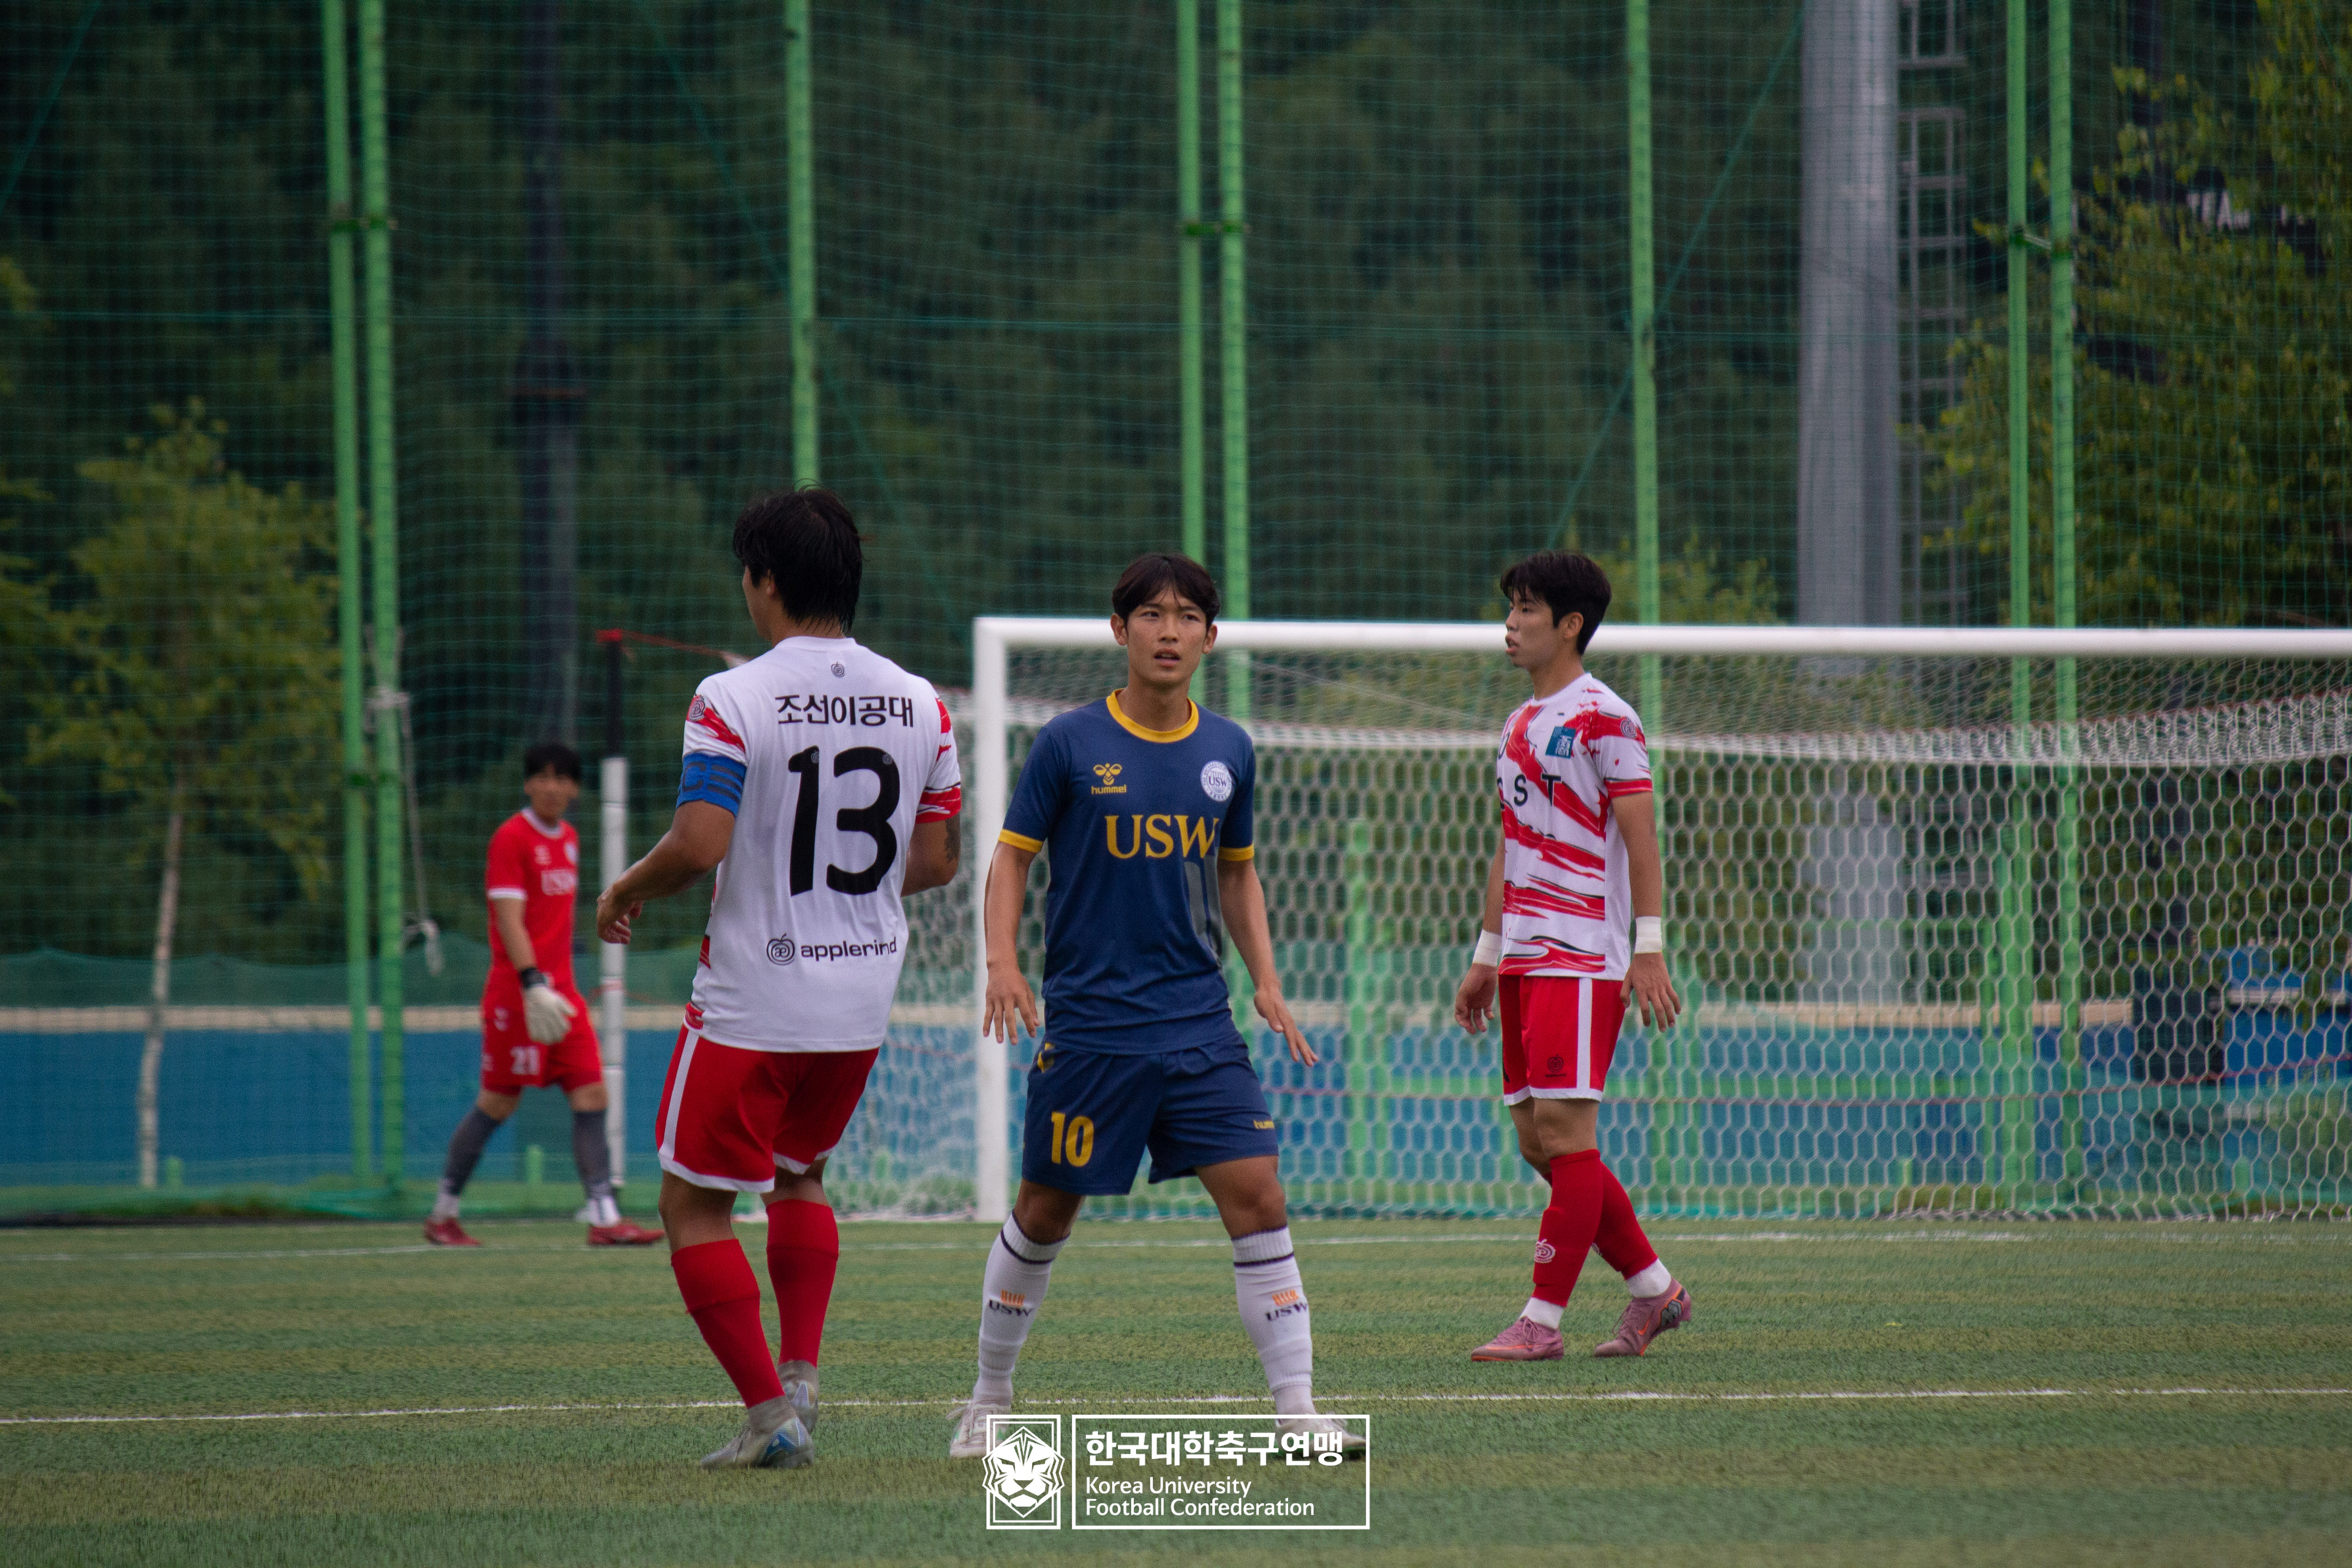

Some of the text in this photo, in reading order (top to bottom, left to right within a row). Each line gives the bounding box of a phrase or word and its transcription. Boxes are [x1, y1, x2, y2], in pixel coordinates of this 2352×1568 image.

[775, 695, 913, 727] 조선이공대
[1091, 784, 1127, 795] hummel
[1209, 776, 1226, 787] USW
[788, 745, 901, 897] 13
[1104, 814, 1220, 859] USW
[800, 936, 897, 962] applerind
[1051, 1112, 1094, 1167] 10
[989, 1299, 1035, 1317] USW
[1266, 1303, 1308, 1322] USW
